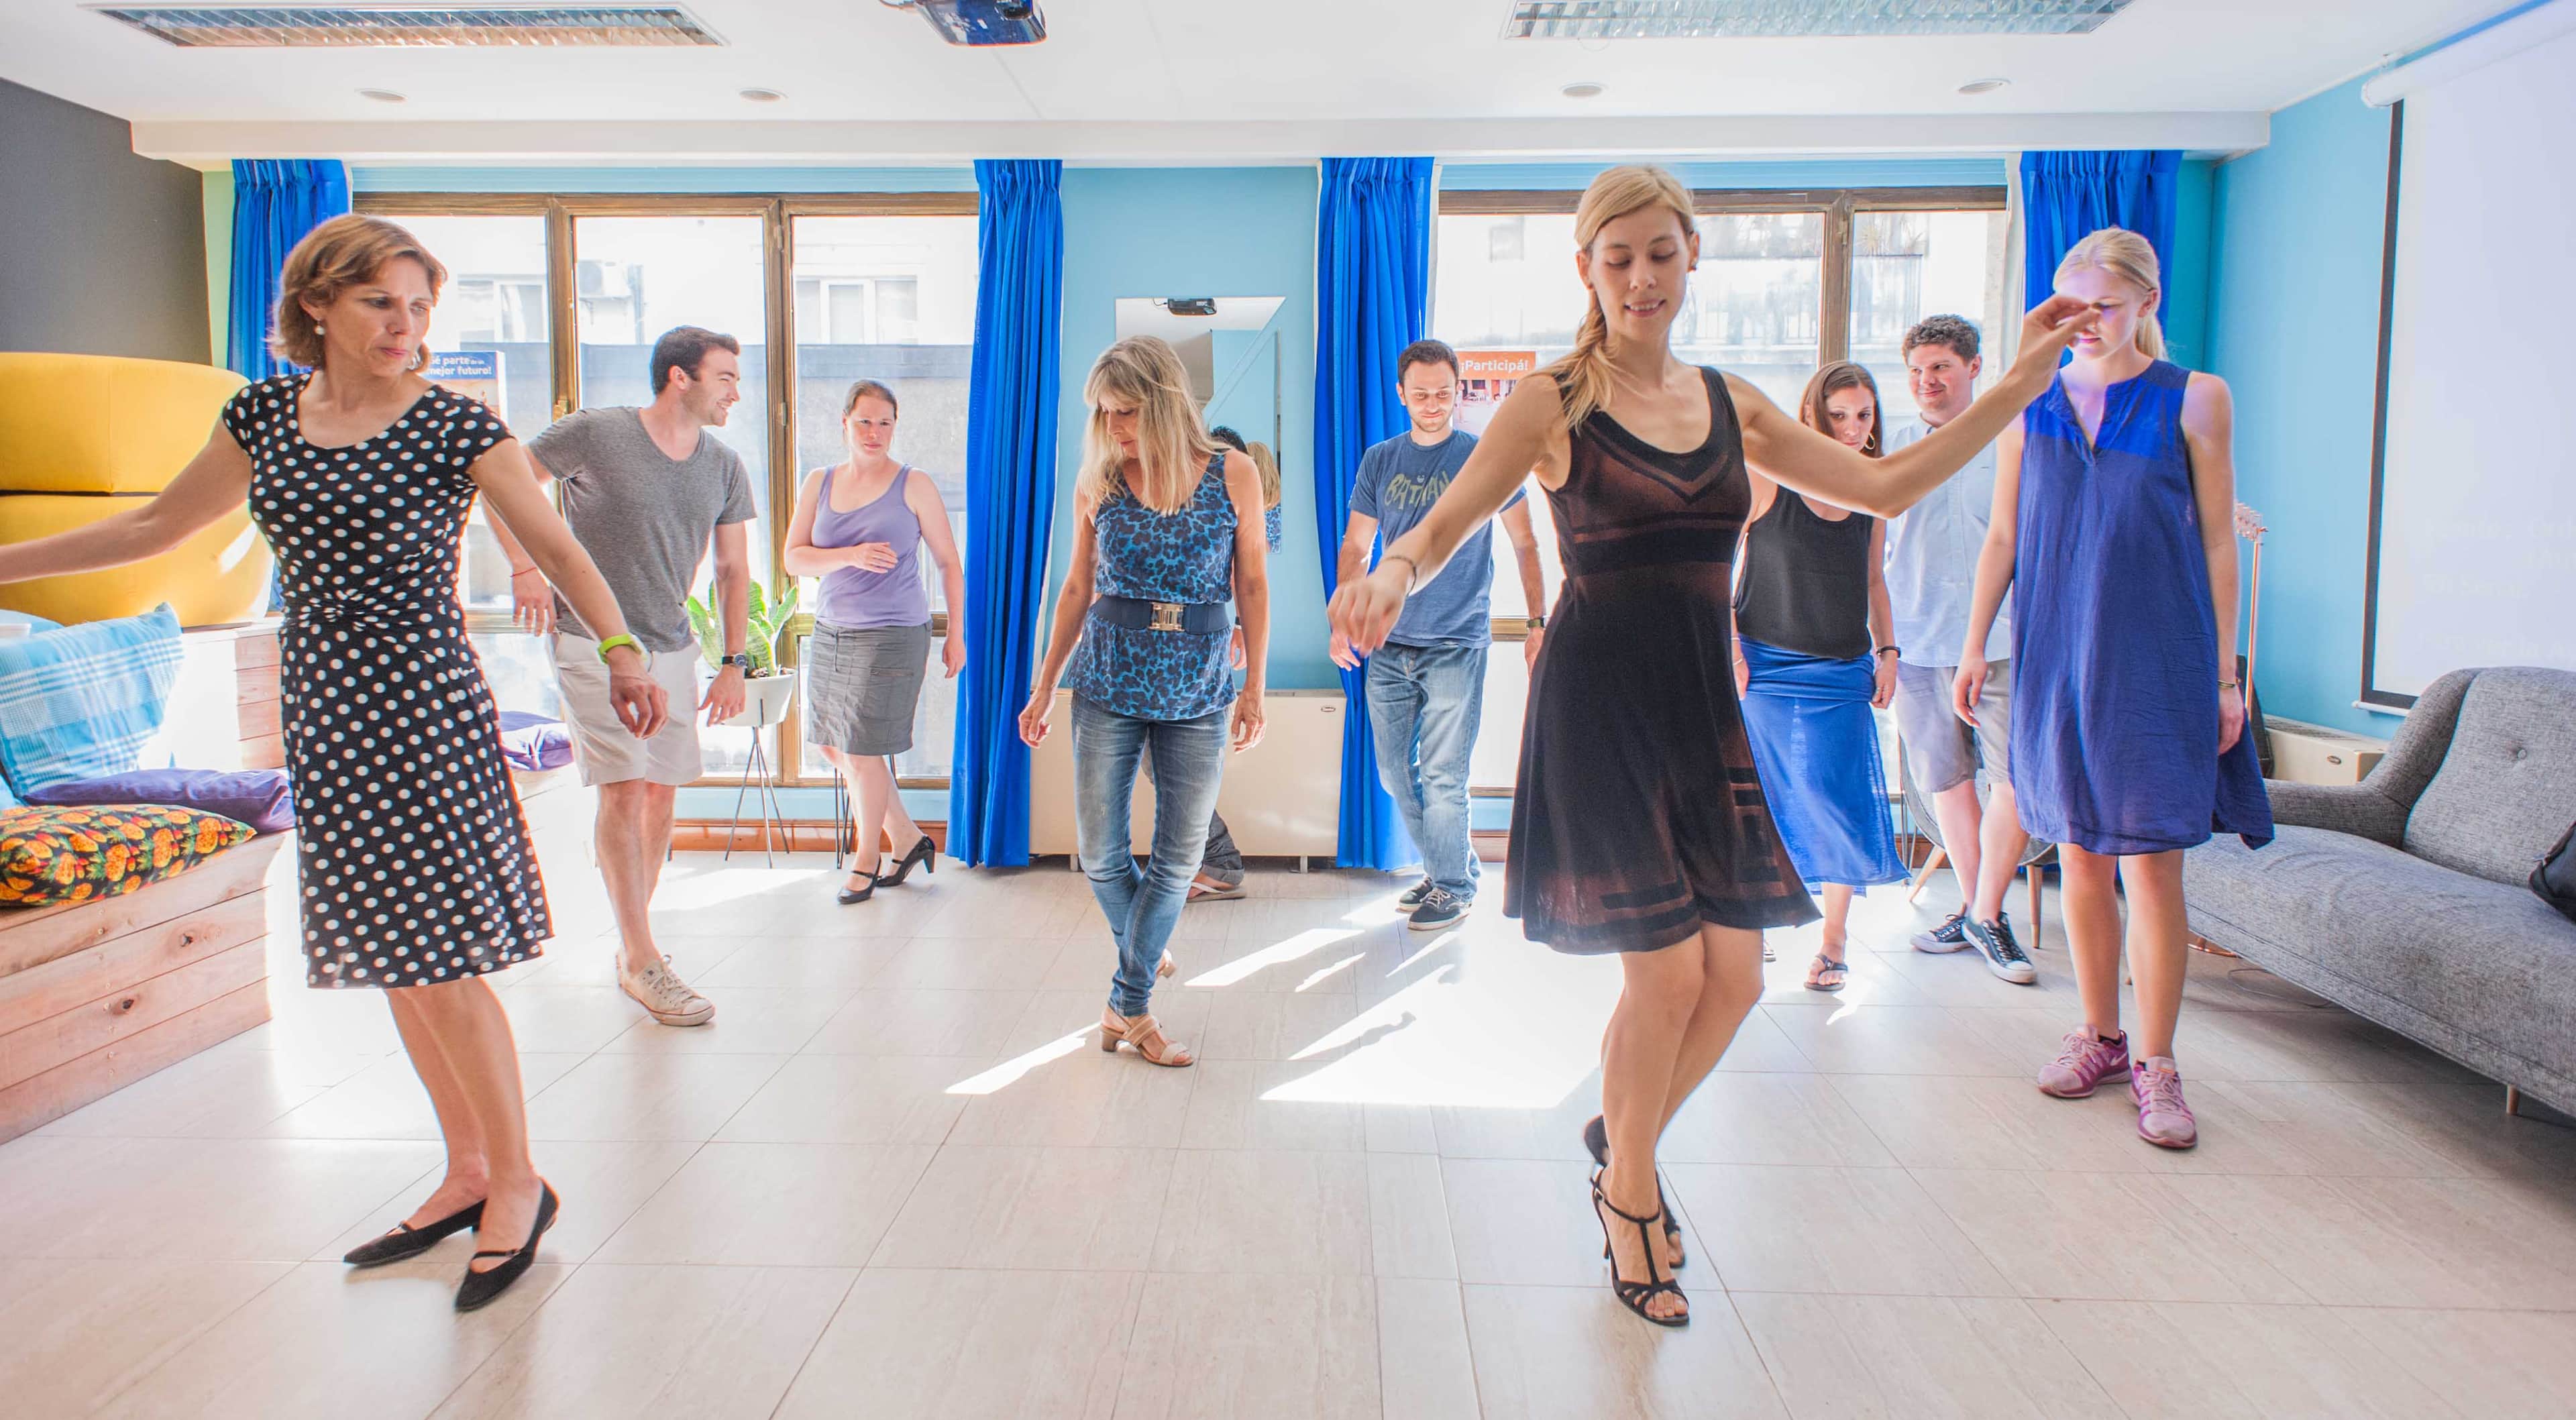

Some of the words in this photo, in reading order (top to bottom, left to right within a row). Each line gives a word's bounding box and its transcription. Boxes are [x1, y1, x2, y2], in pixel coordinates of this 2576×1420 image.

[443, 356, 470, 366] parte
[1458, 358, 1528, 373] ¡Participá!
[429, 366, 455, 377] mejor
[457, 366, 492, 375] futuro!
